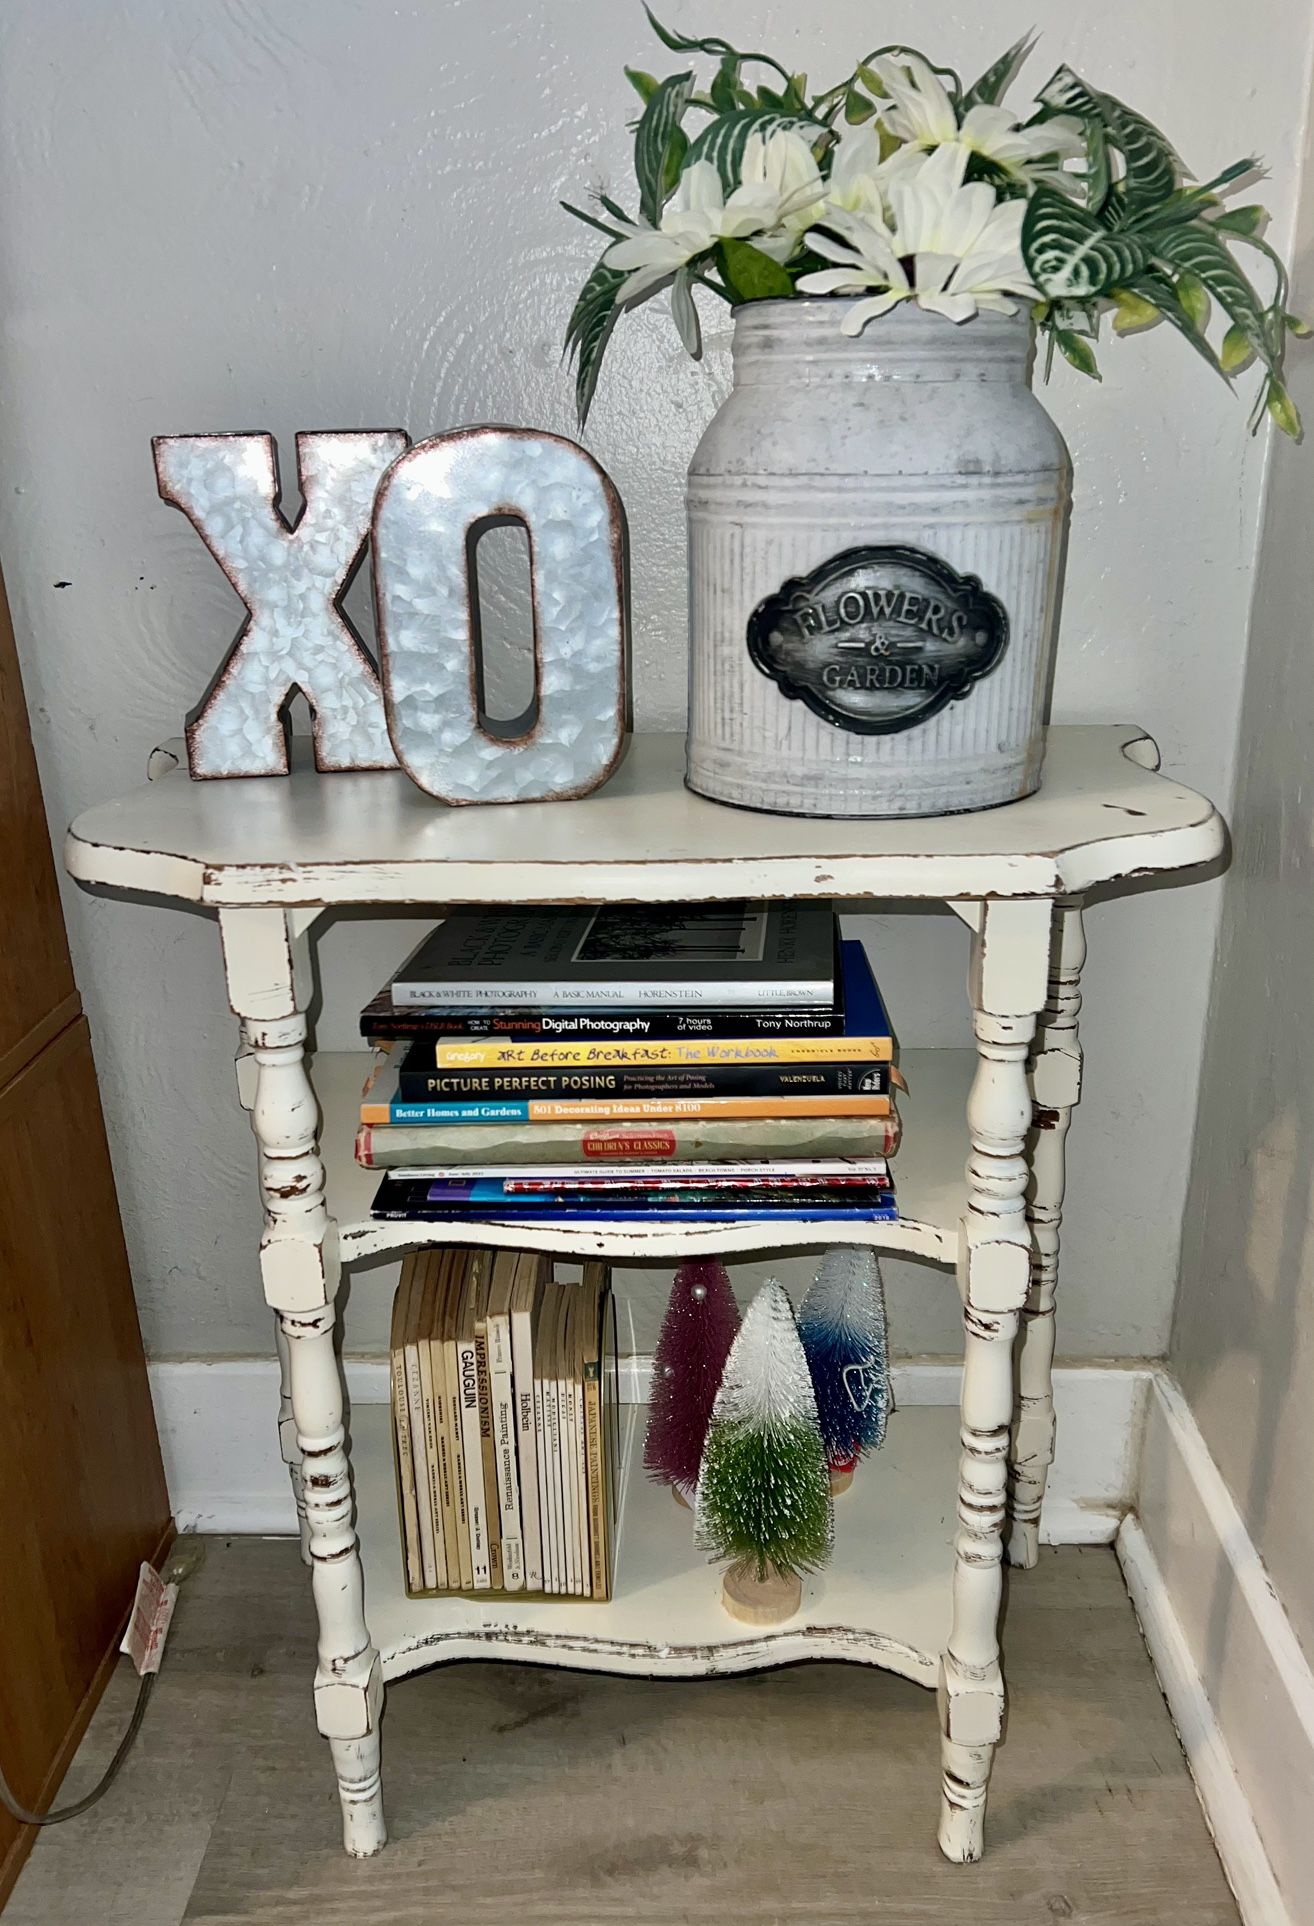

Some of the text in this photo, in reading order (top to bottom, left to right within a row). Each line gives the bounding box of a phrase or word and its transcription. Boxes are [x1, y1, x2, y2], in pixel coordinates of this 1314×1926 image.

[793, 589, 968, 645] FLOWERS
[870, 632, 891, 656] &
[822, 664, 941, 688] GARDEN
[476, 990, 538, 998] PHOTOGRAPHY
[552, 990, 624, 998] A BASIC MANUAL
[638, 990, 702, 998] HORENSTEIN
[493, 1017, 650, 1033] Stunning Digital Photography
[678, 1017, 712, 1025] 7 hours
[756, 1018, 832, 1030] Tony Northrup
[530, 1049, 581, 1062] Before
[676, 1047, 701, 1060] The
[707, 1046, 779, 1059] Workbook
[427, 1075, 616, 1092] PICTURE PERFECT POSING
[779, 1074, 826, 1083] VALENZUELA
[396, 1107, 522, 1118] Better Homes and Gardens
[554, 1106, 610, 1116] Decorating
[612, 1104, 641, 1114] Ideas
[643, 1103, 673, 1113] Under
[587, 1141, 670, 1151] CHILDREN'S CLASSICS
[462, 1350, 476, 1408] GAUGUIN
[475, 1335, 490, 1438] IMPRESSIONISM
[396, 1364, 406, 1412] TOULOUSE
[520, 1393, 532, 1432] Holbein
[588, 1401, 598, 1448] JAPANESE
[500, 1402, 514, 1511] Renaissance Painting
[589, 1452, 600, 1504] PAINTINGS
[490, 1543, 500, 1569] Crown
[475, 1566, 486, 1574] 11
[512, 1572, 519, 1580] 8
